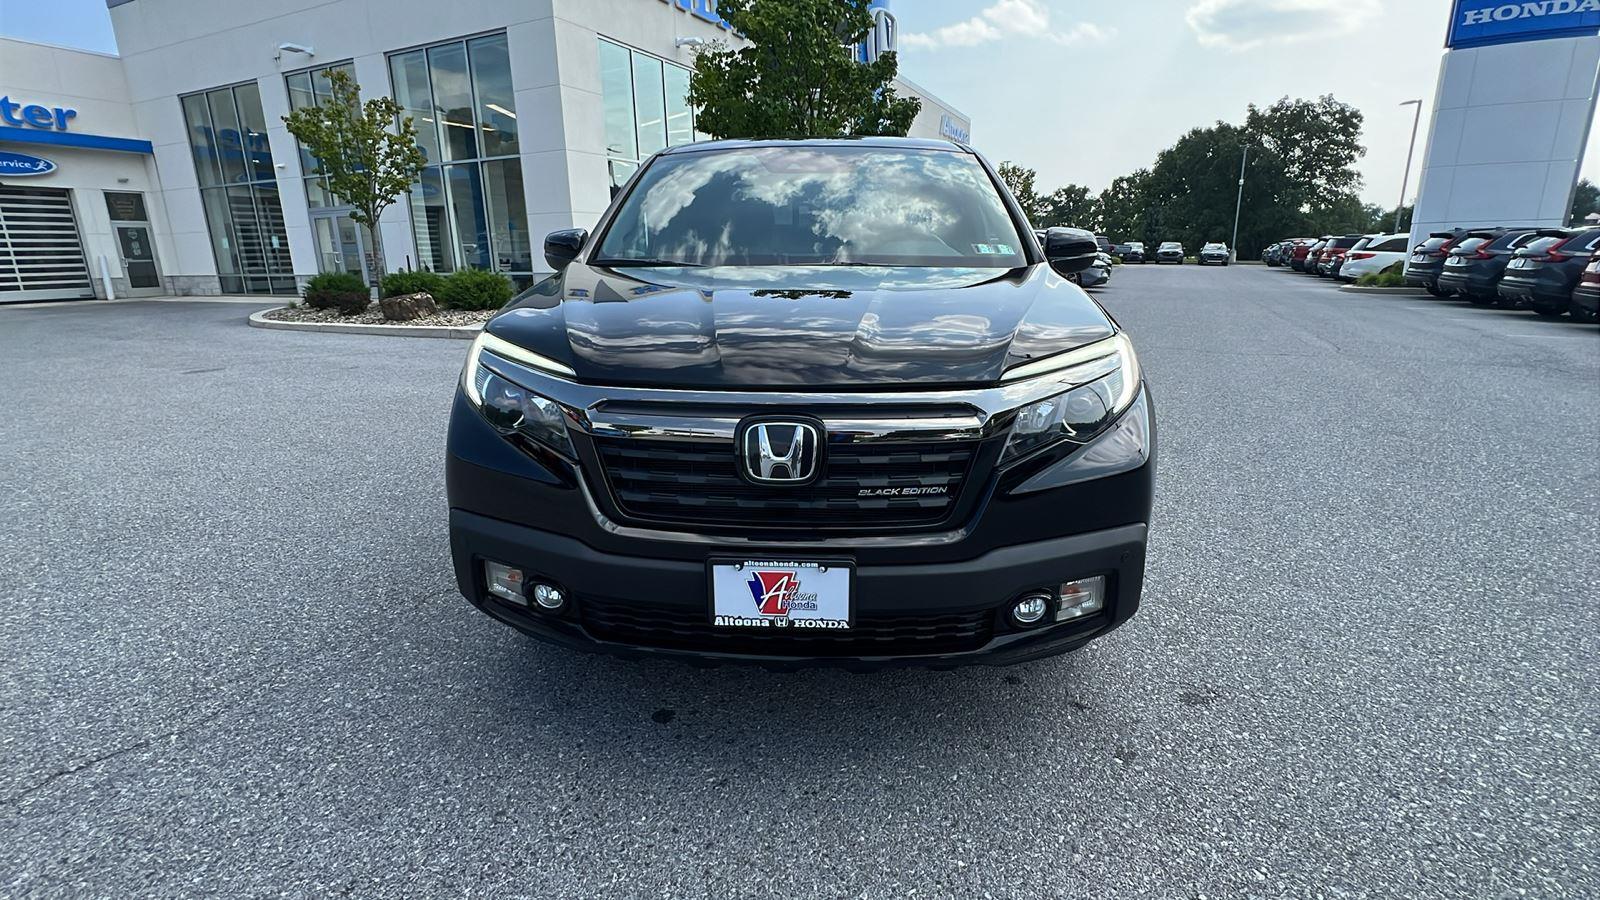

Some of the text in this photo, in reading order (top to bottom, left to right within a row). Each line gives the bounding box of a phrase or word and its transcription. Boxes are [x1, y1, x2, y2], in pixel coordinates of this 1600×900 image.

[1461, 0, 1600, 26] HONDA
[858, 486, 948, 496] BLACK EDITION
[743, 560, 819, 568] altoonahonda.com
[759, 575, 817, 610] Altoona
[782, 600, 817, 610] Honda
[714, 616, 770, 627] Altoona
[793, 619, 850, 629] HONDA
